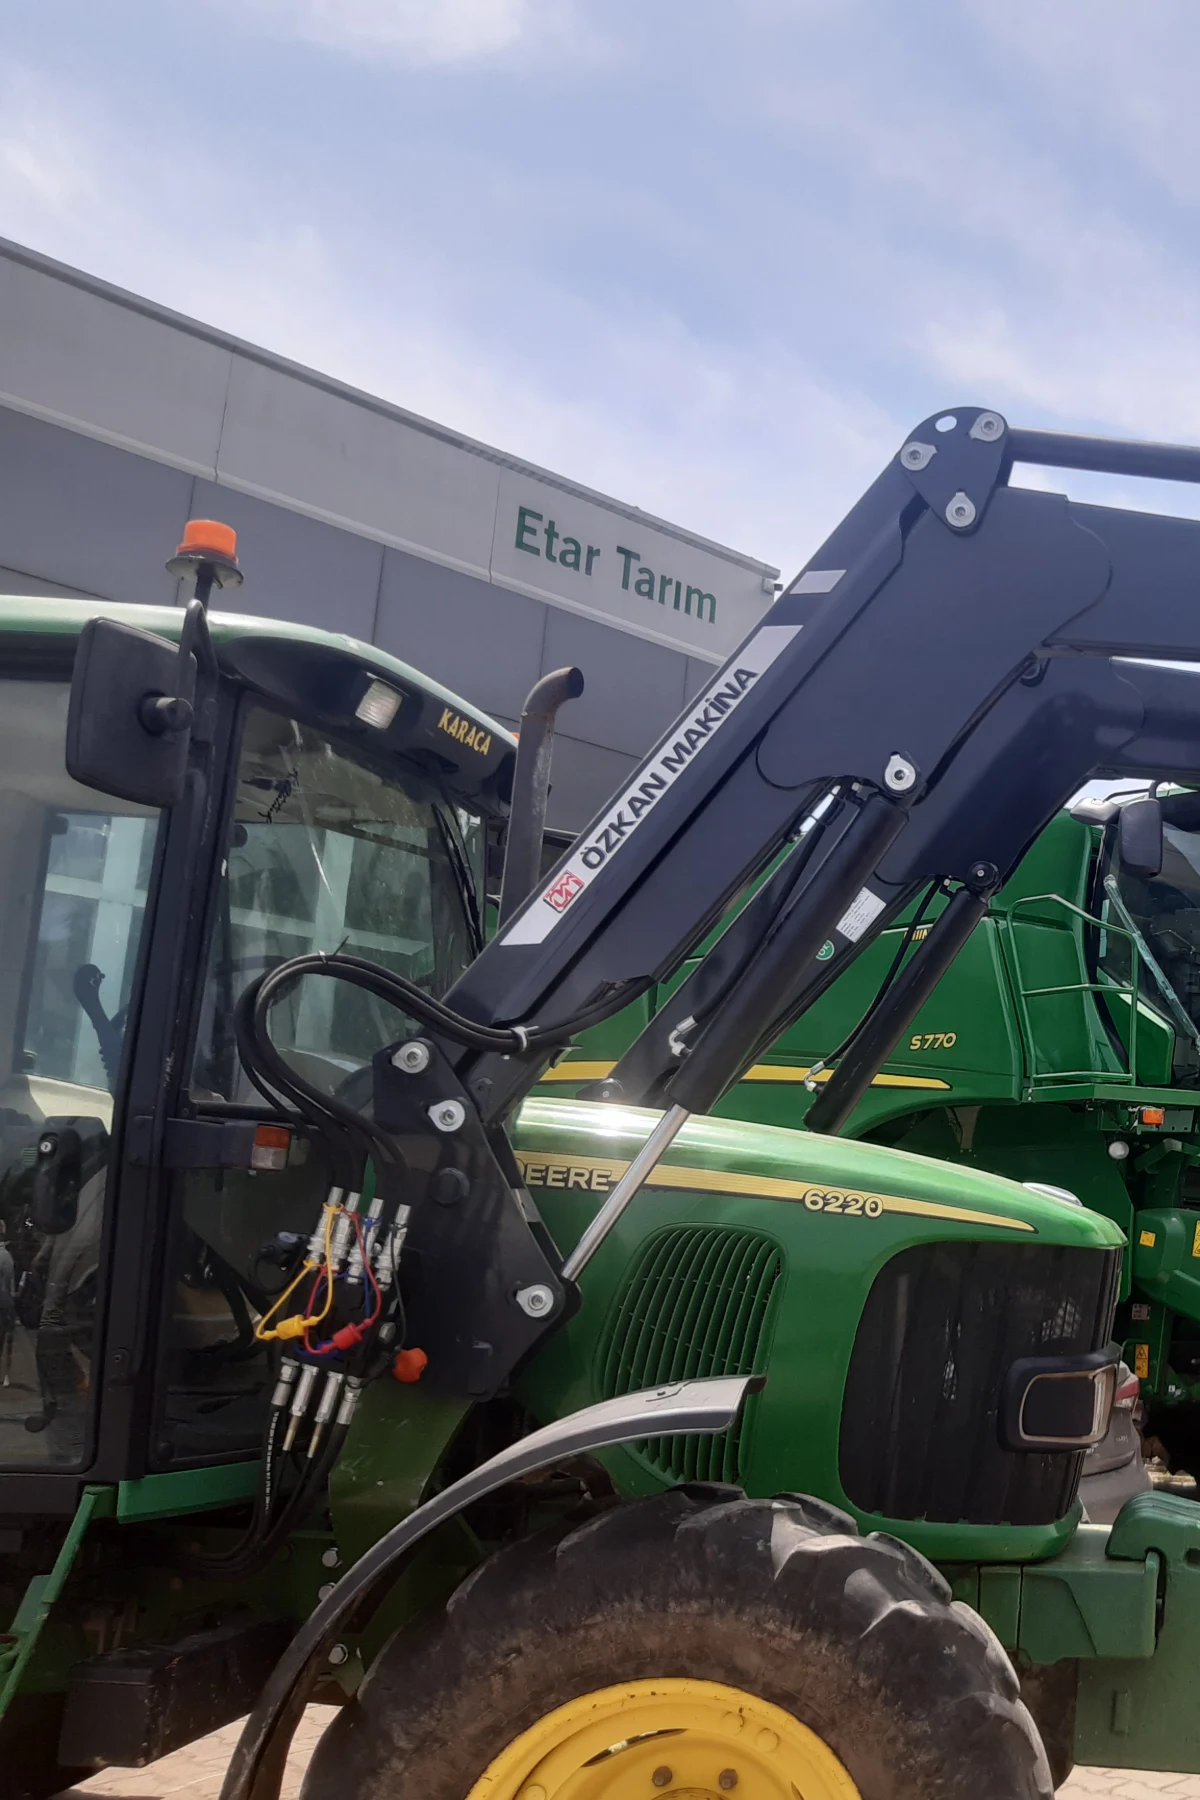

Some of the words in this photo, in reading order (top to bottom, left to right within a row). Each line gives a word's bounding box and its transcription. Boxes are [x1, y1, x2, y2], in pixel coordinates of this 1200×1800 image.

[515, 506, 601, 576] Etar
[616, 545, 717, 624] Tarım
[437, 708, 492, 756] KARACA
[580, 772, 669, 870] ÖZKAN
[660, 667, 760, 774] MAKİNA
[909, 1032, 957, 1050] S770
[516, 1158, 613, 1192] EERE
[803, 1188, 883, 1219] 6220
